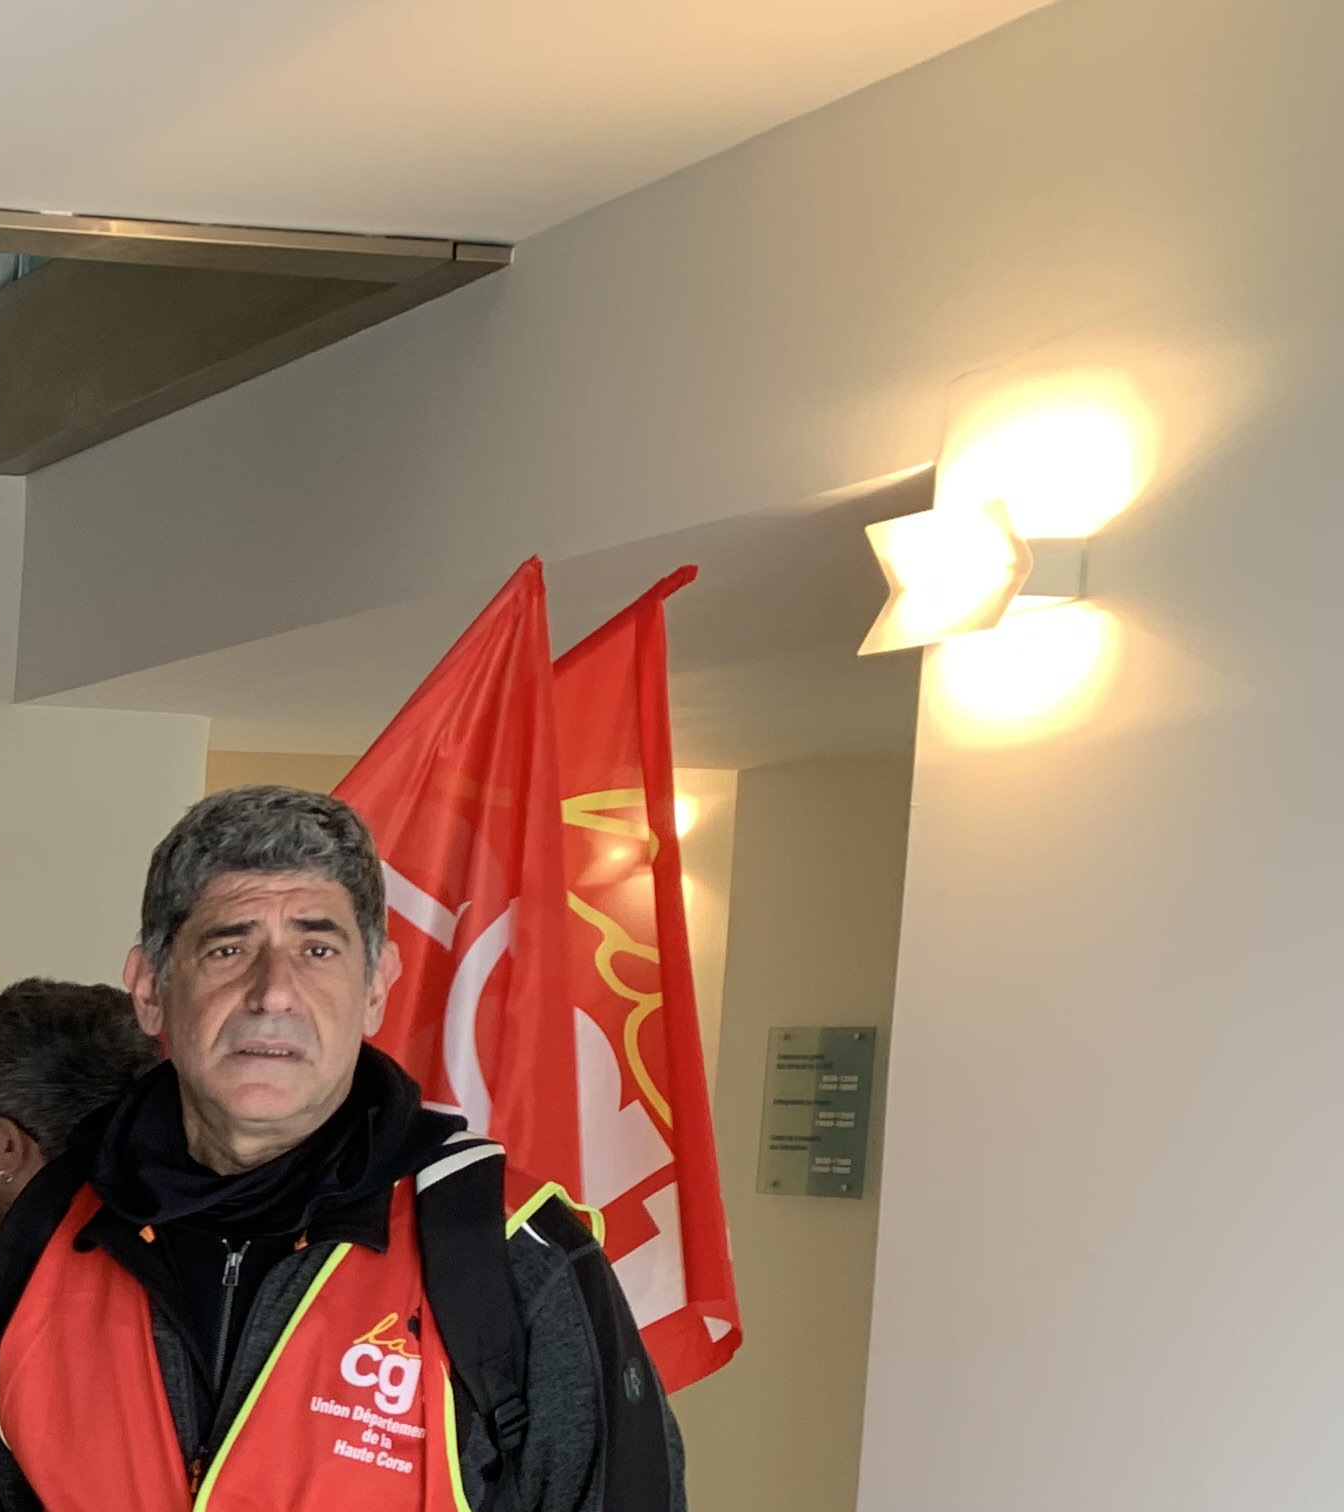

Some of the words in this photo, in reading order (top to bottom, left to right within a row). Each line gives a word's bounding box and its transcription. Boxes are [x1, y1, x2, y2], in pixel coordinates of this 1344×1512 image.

[340, 1343, 422, 1415] cg
[310, 1396, 350, 1419] Union
[351, 1405, 426, 1439] Départemen
[332, 1439, 375, 1464] Haute
[376, 1451, 413, 1474] Corse
[361, 1428, 379, 1445] de
[381, 1431, 393, 1449] la
